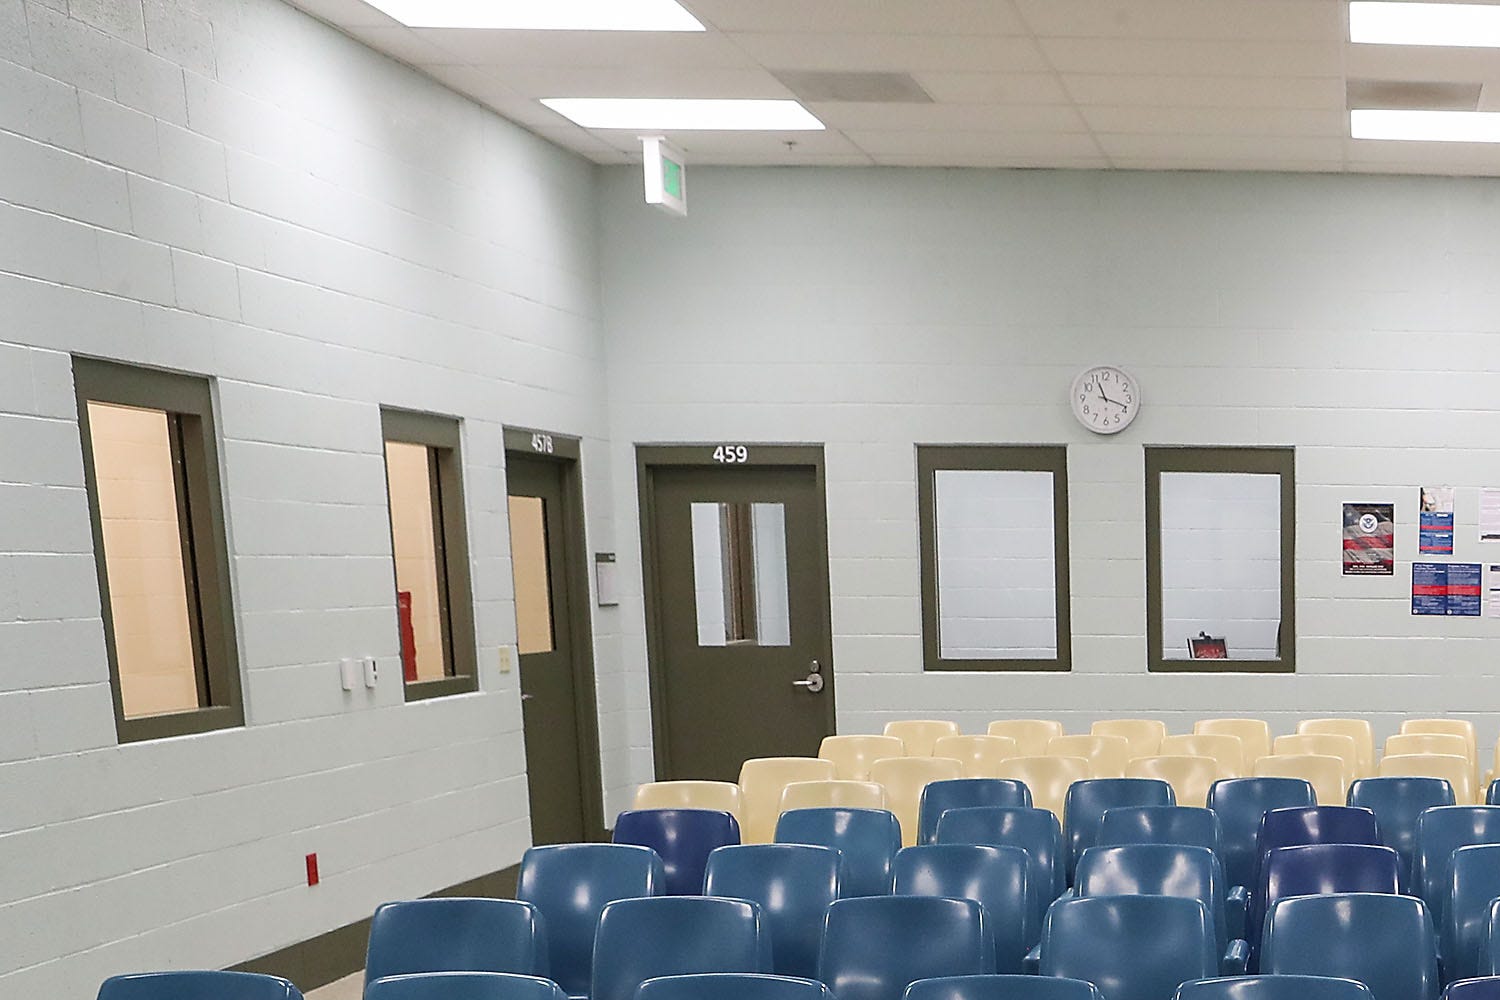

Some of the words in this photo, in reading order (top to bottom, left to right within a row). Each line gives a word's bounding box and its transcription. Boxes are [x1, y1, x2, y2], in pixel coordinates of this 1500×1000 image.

[1091, 374, 1099, 383] 11
[1101, 371, 1110, 381] 12
[1084, 382, 1093, 392] 10
[1122, 382, 1128, 392] 2
[1080, 393, 1086, 403] 9
[1125, 394, 1132, 404] 3
[1083, 404, 1090, 415] 8
[1121, 404, 1128, 414] 4
[1093, 413, 1099, 422] 7
[1103, 416, 1109, 426] 6
[1114, 413, 1121, 423] 5
[712, 445, 748, 463] 459
